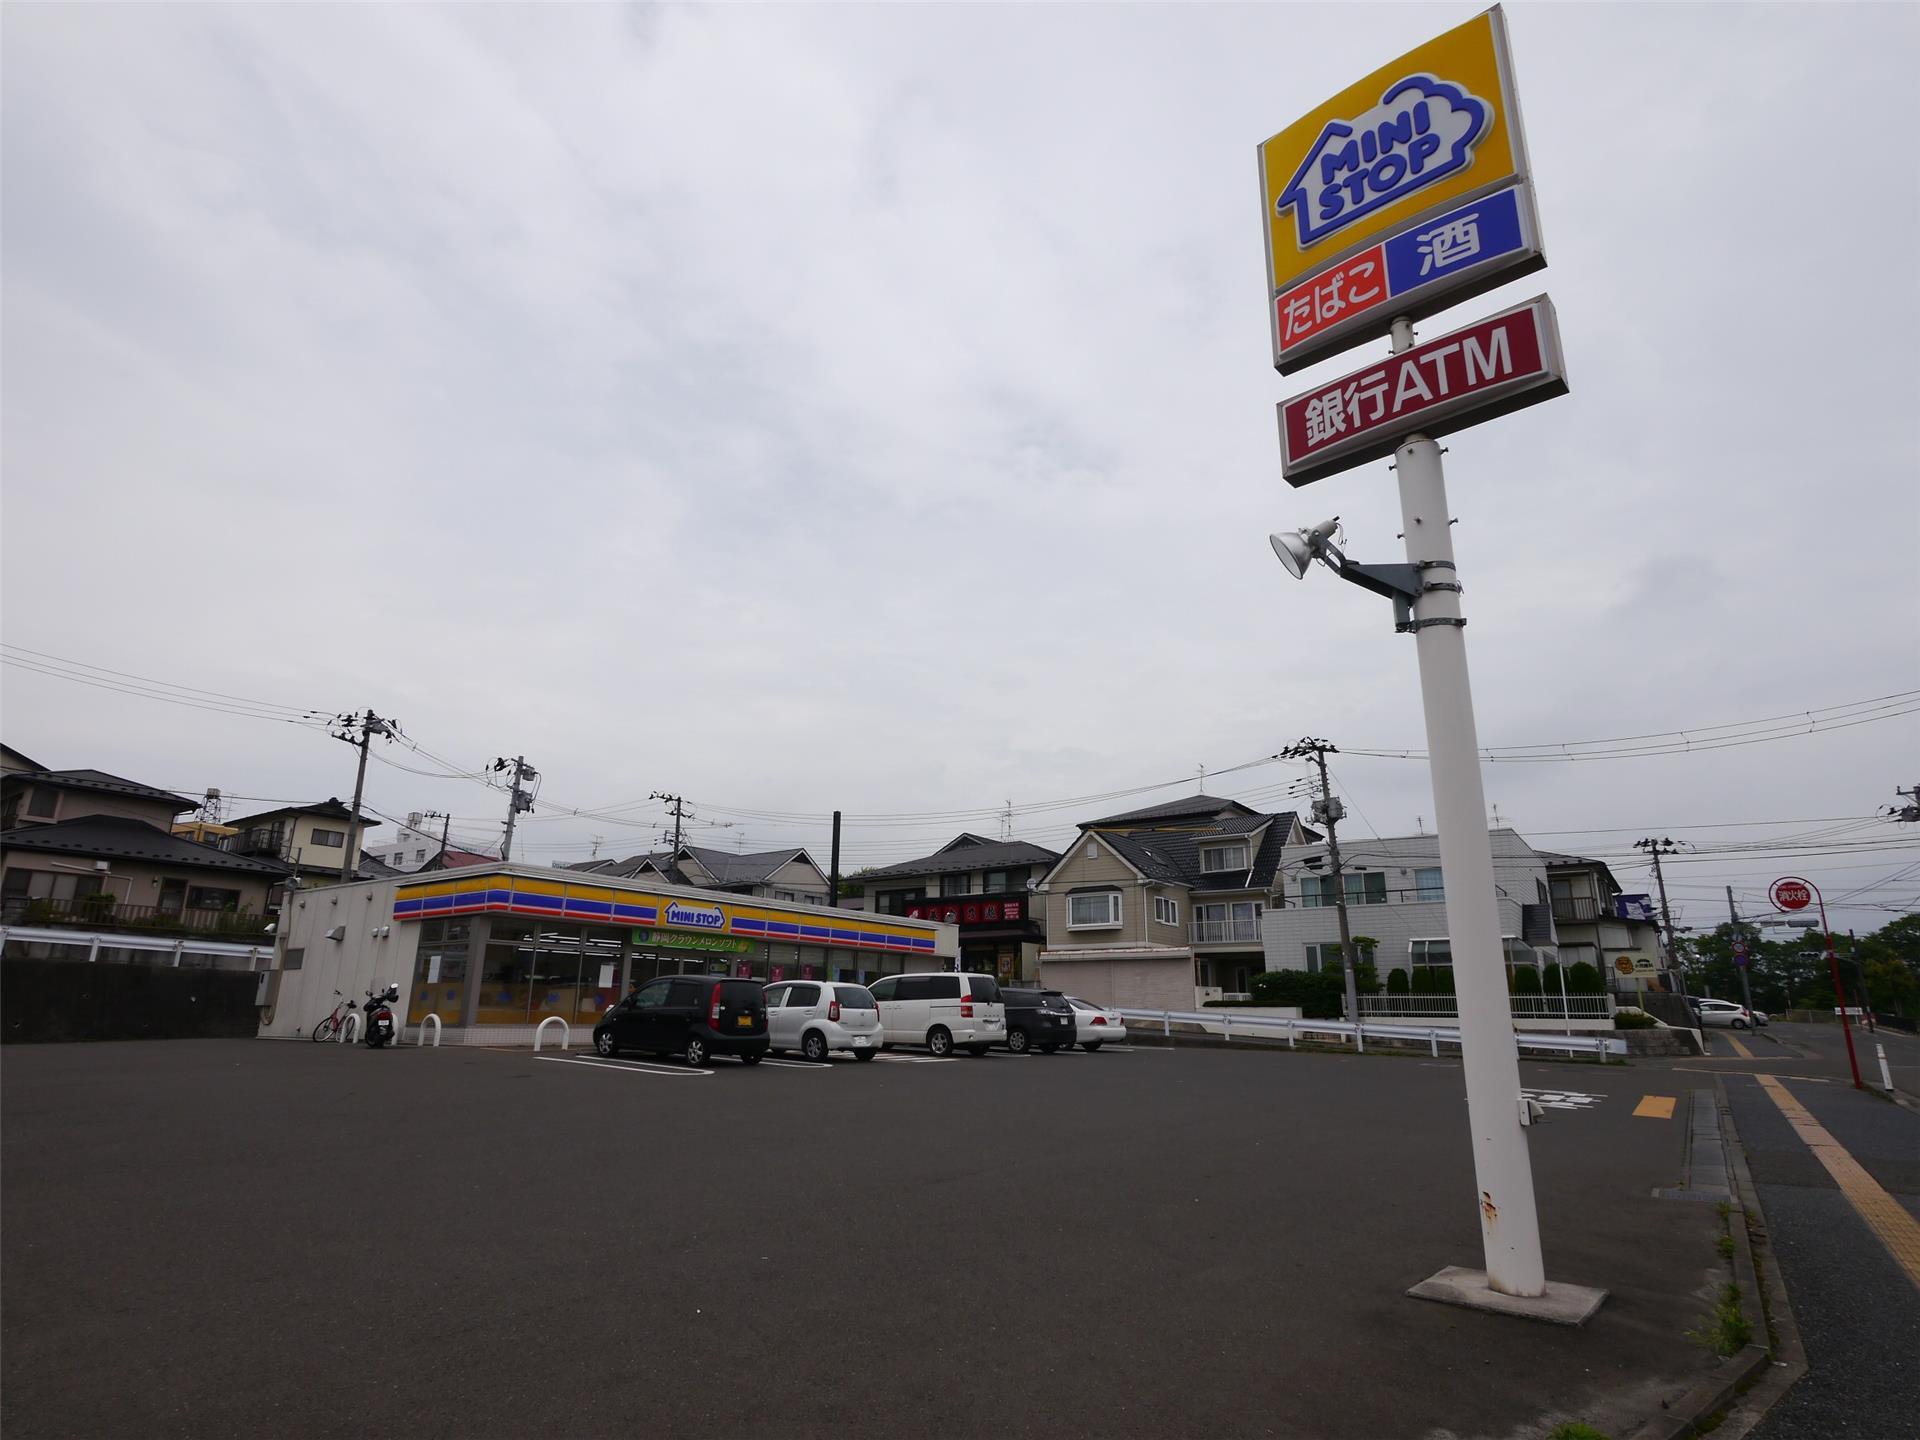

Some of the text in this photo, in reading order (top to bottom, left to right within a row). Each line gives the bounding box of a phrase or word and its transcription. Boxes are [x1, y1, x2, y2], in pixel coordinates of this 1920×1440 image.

[1319, 133, 1440, 220] STOP
[1321, 101, 1431, 185] MINI
[1417, 213, 1480, 276] 酒
[1283, 260, 1380, 341] たばこ
[1304, 326, 1513, 448] 銀行ATM
[671, 910, 720, 925] MINI STOP
